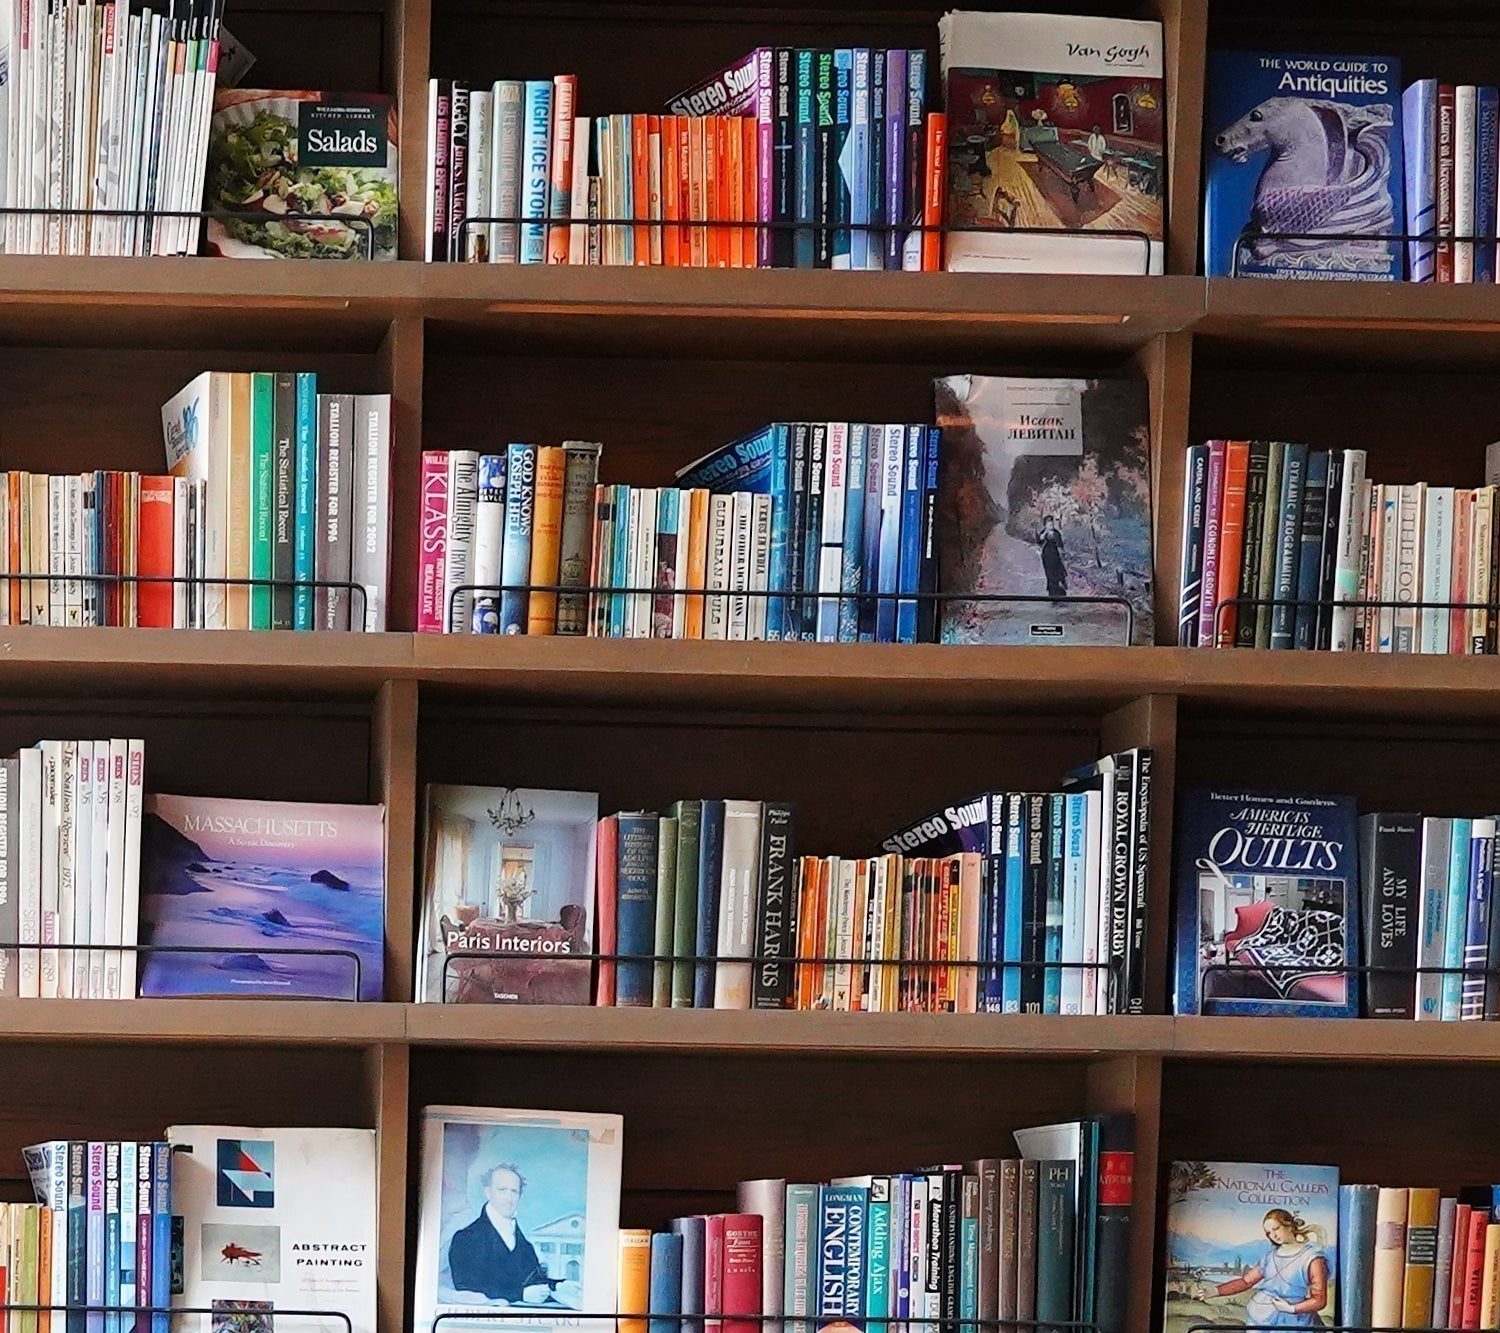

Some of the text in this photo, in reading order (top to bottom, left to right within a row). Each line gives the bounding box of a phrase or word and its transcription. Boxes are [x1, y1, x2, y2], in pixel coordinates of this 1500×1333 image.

[1065, 43, 1150, 64] Van Gogh
[1259, 58, 1388, 73] THE WORLD GUIDE TO
[1279, 72, 1388, 97] Antiquities
[306, 128, 378, 153] Salads
[1019, 413, 1064, 427] Исаак
[1006, 427, 1076, 442] ЛЕВИТАН
[183, 817, 338, 839] MASSACHUSETTS
[1207, 830, 1344, 873] QUILTS
[763, 834, 787, 988] FRANK HARRIS
[446, 931, 572, 954] Paris Interiors
[292, 1243, 368, 1253] ABSTRACT
[296, 1258, 363, 1268] PAINTING
